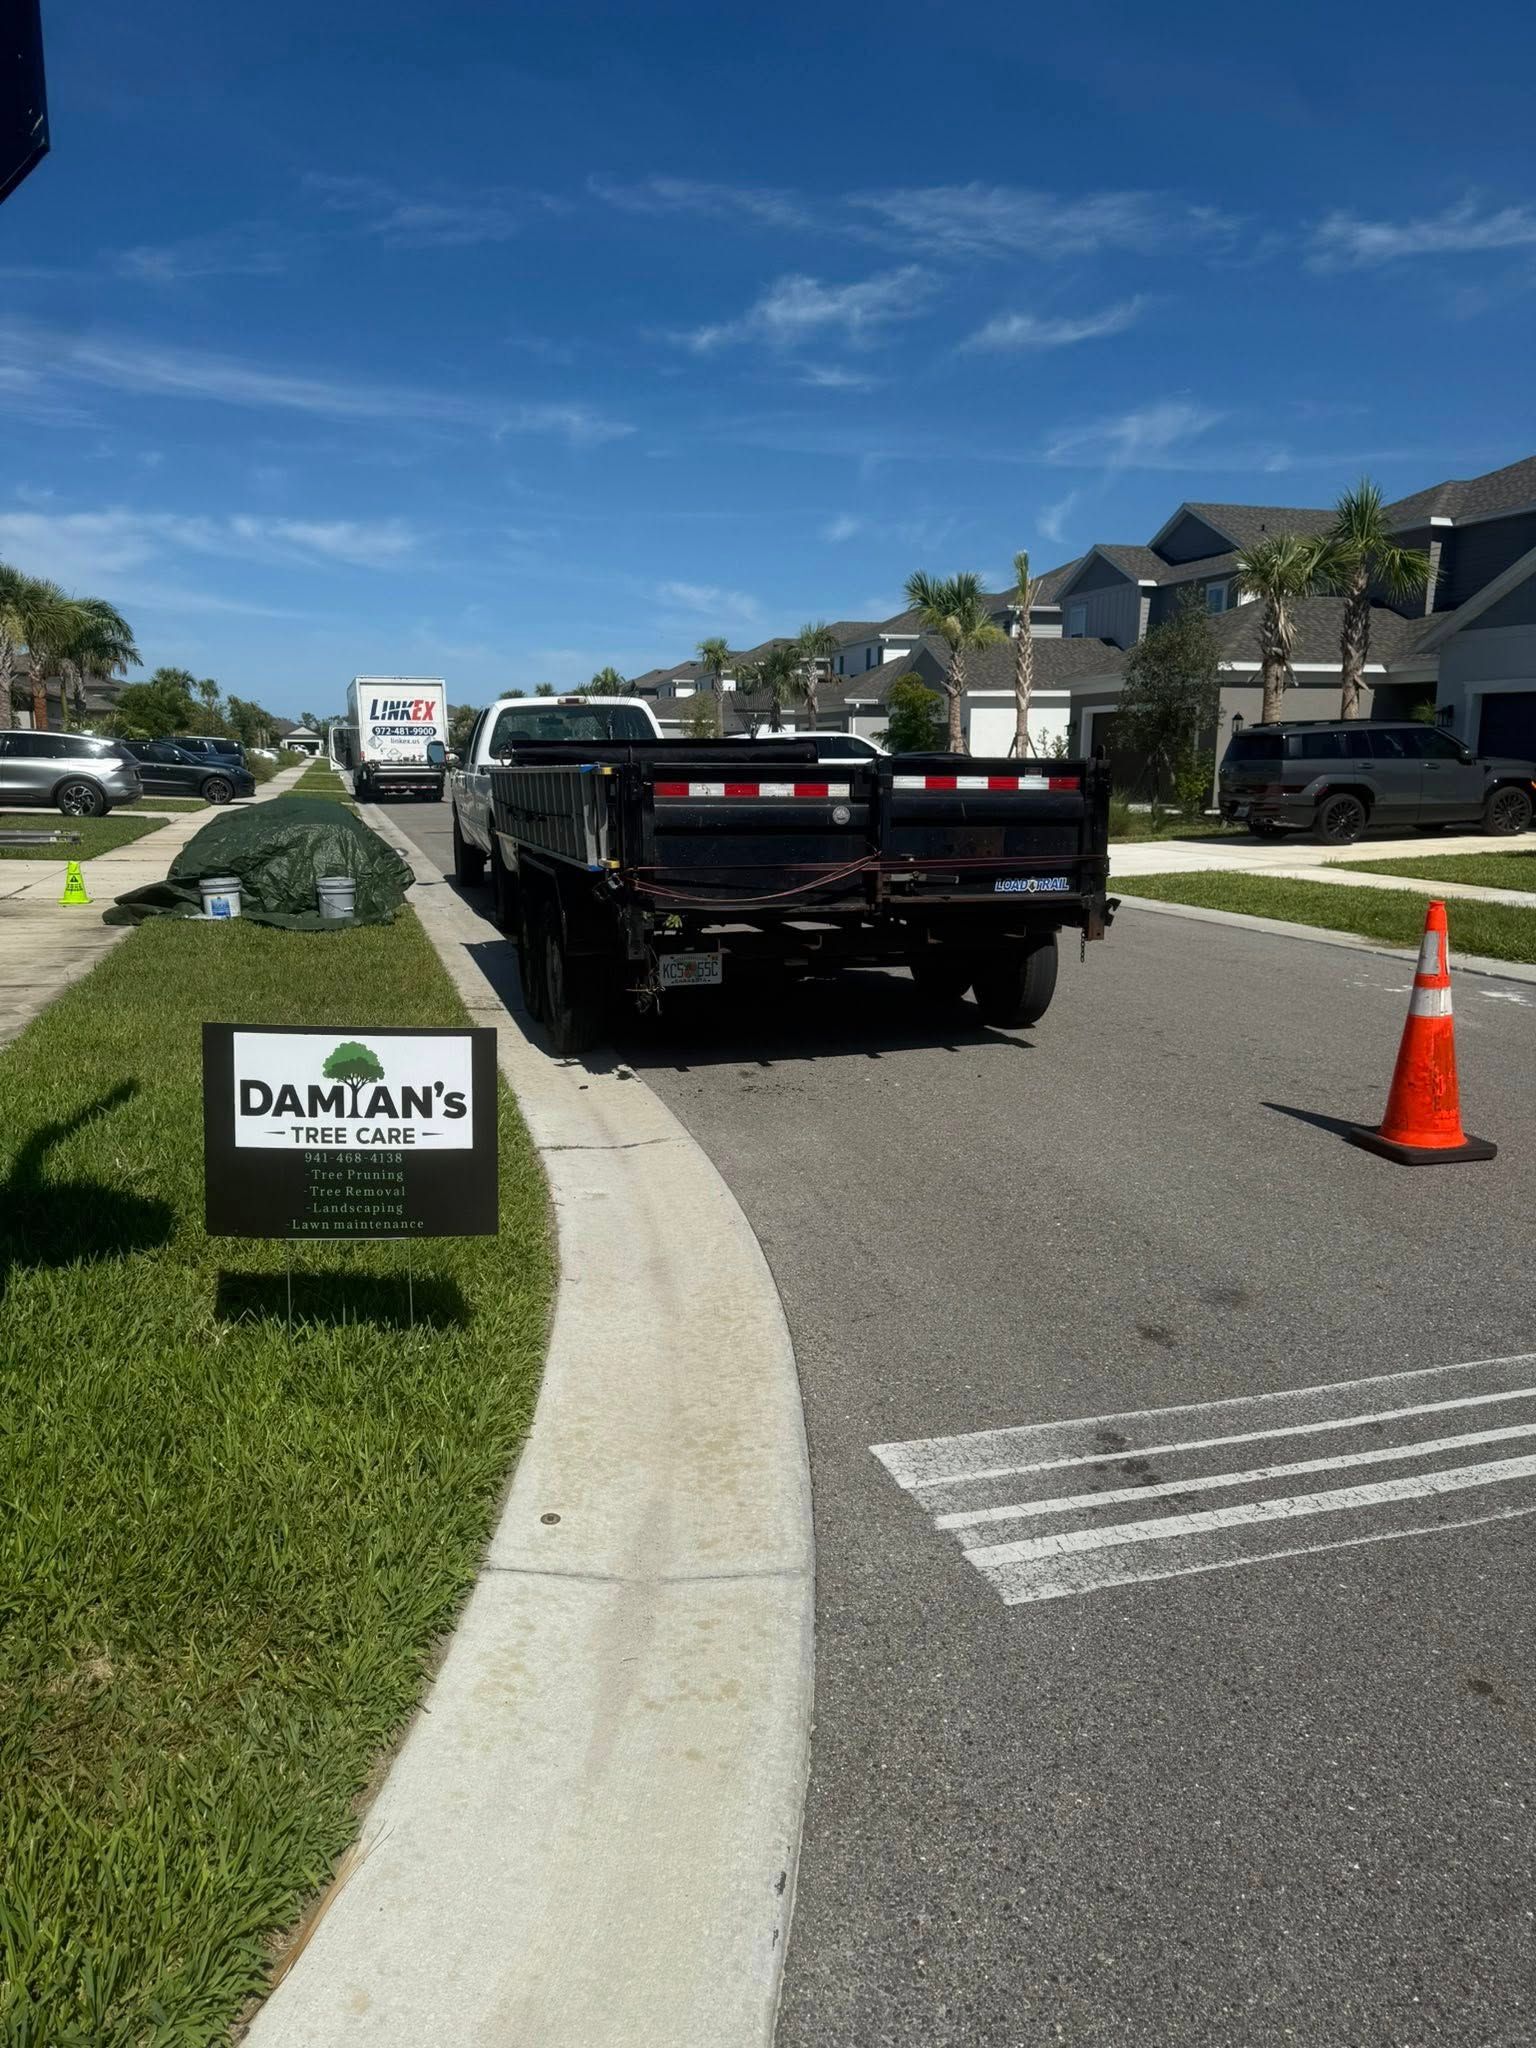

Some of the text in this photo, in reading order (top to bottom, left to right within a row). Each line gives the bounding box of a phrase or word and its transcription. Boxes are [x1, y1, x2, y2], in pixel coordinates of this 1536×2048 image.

[374, 727, 434, 735] 972-481-9900
[994, 877, 1070, 892] LOAD TRAIL
[291, 1126, 416, 1145] TREE CARE
[304, 1151, 403, 1164] 941-468-4138
[347, 1169, 404, 1182] Pruning
[345, 1185, 406, 1197] Removal
[333, 1218, 424, 1230] maintenance
